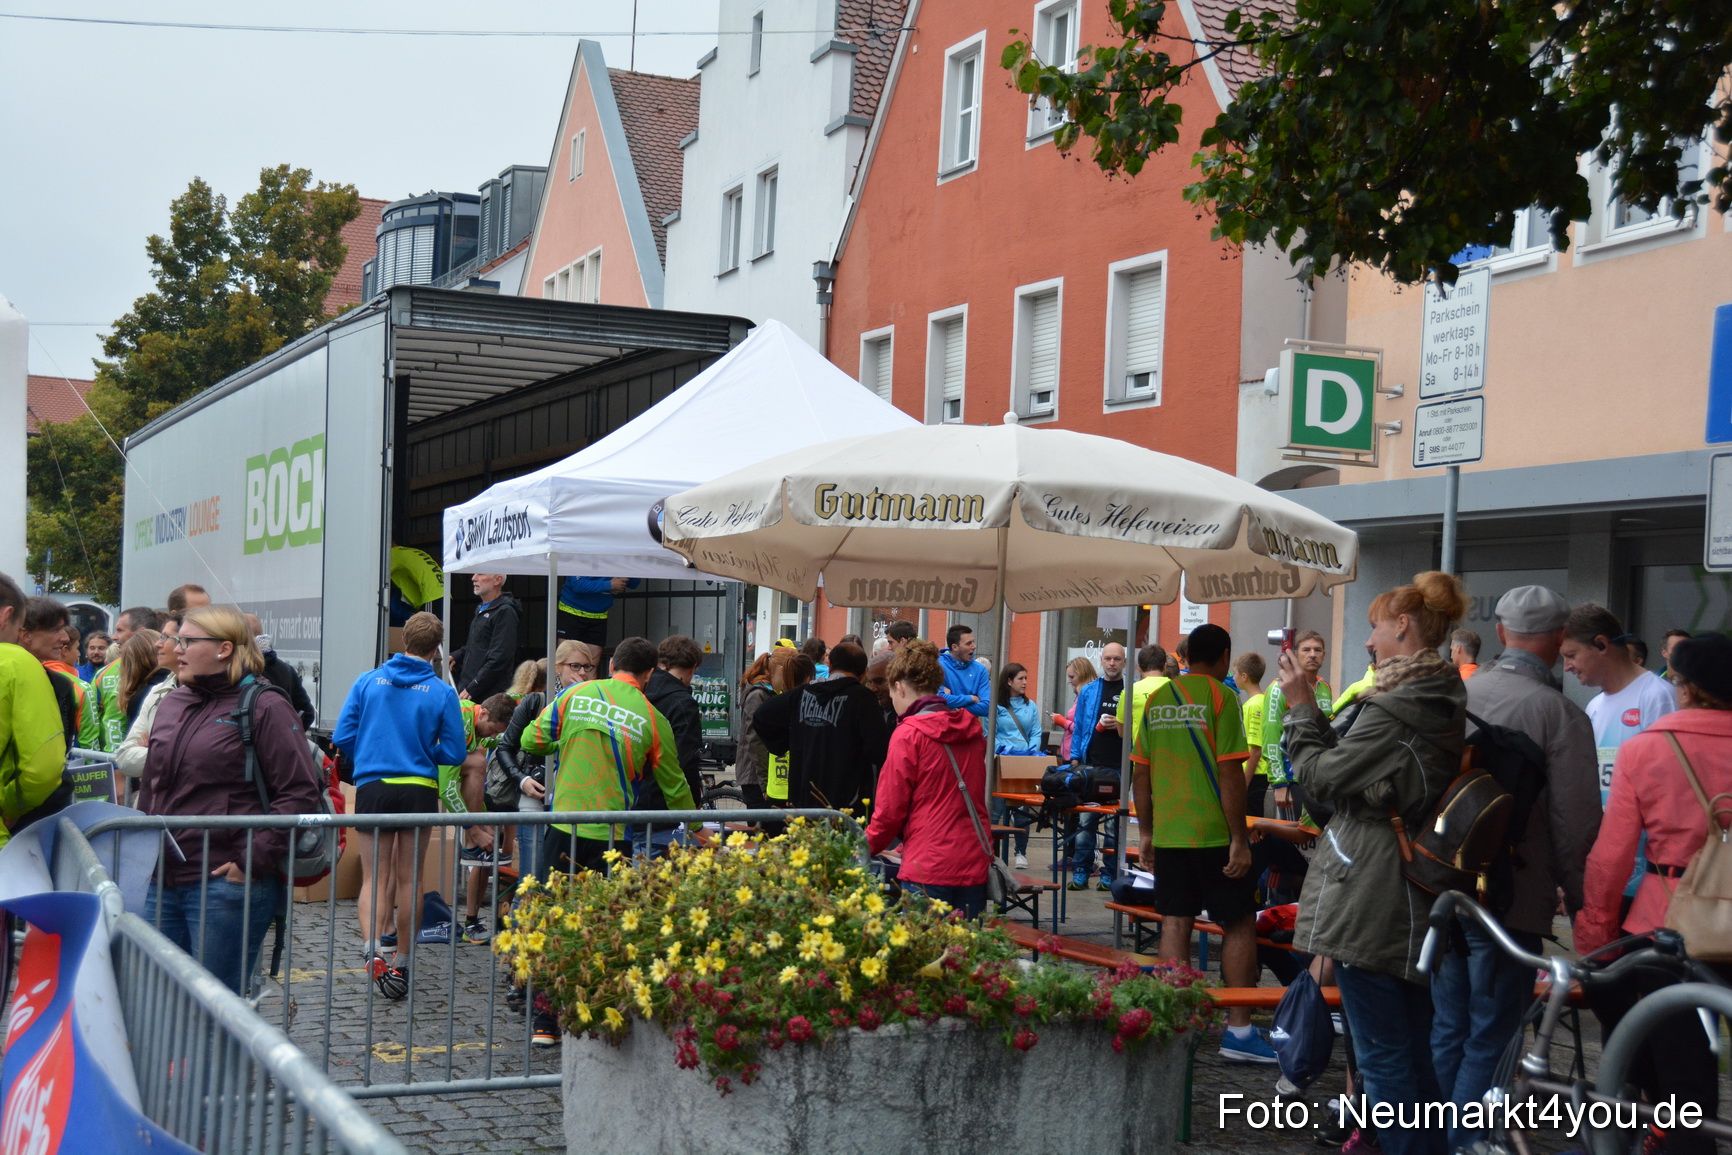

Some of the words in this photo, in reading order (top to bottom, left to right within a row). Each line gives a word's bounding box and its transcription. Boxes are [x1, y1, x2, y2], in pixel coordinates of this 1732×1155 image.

[1458, 282, 1473, 298] mit
[1430, 301, 1480, 325] Parkschein
[1433, 325, 1475, 344] werktags
[1425, 348, 1452, 366] Mo-Fr
[1425, 373, 1436, 386] Sa
[1429, 445, 1440, 454] SMS
[815, 483, 985, 524] Gutmann
[134, 516, 154, 551] OFFICE
[155, 505, 188, 546] INDUSTRY
[189, 495, 221, 537] LOUNGE
[674, 506, 719, 529] Gutes
[1042, 493, 1091, 526] Gutes
[1098, 503, 1221, 537] Hefeweizen
[465, 516, 488, 552] BMW
[488, 505, 532, 549] Laufsport
[280, 613, 302, 640] smart
[376, 677, 393, 686] Tea
[569, 695, 648, 737] BOCK
[569, 714, 591, 723] inspired
[1149, 704, 1207, 724] BOCK
